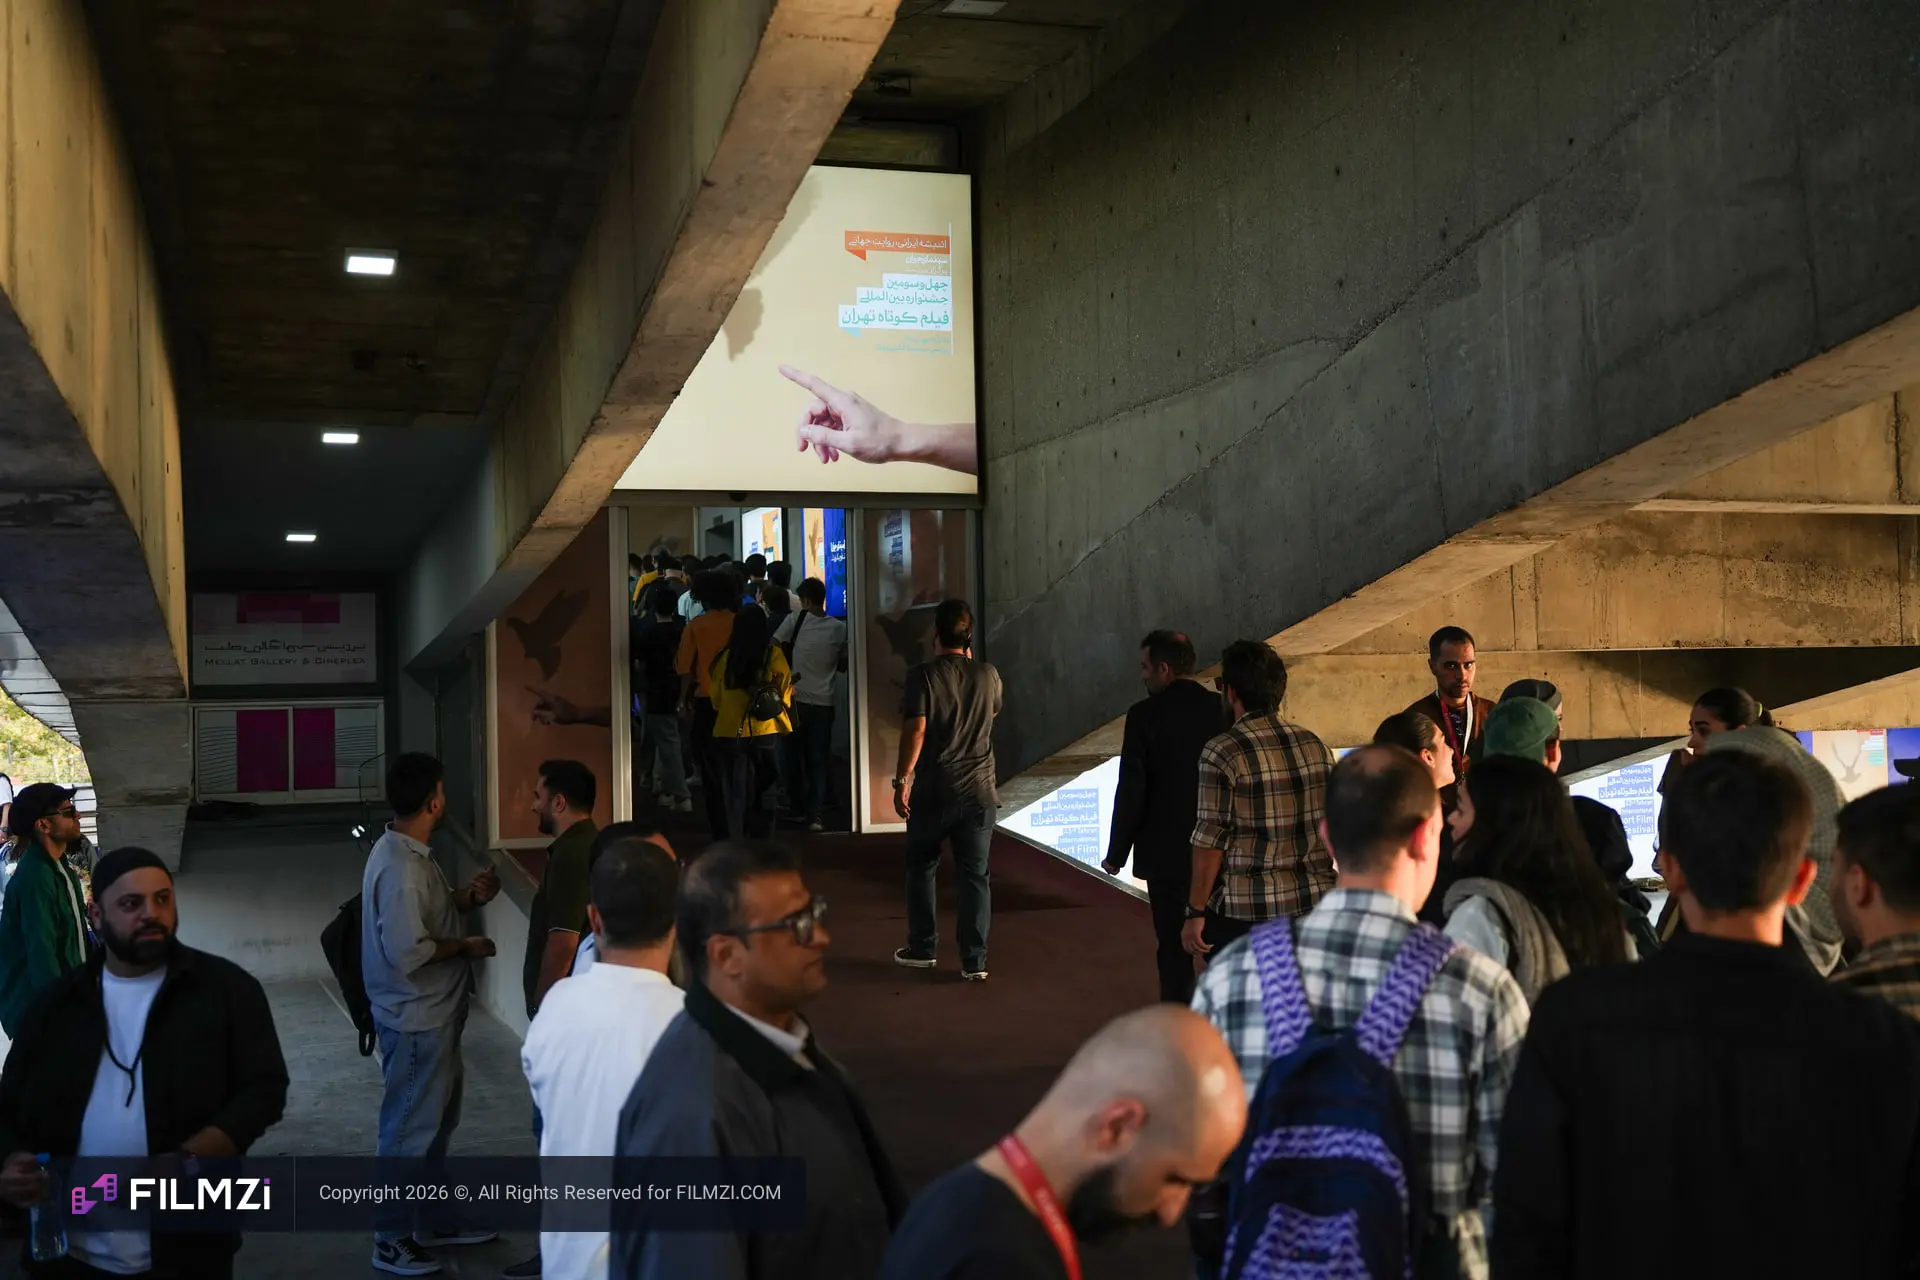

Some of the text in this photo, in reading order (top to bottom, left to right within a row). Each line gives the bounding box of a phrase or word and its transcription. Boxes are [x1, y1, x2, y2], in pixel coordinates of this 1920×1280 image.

[848, 236, 872, 247] جهانی
[919, 239, 947, 249] اندیشه
[906, 291, 948, 305] جشنواره
[841, 308, 949, 328] فیلم کوتاه تهران
[251, 657, 298, 666] GALLERY
[302, 657, 310, 665] &
[1600, 785, 1653, 798] فیلم کوتاه تهران
[1032, 811, 1098, 826] فیلم کوتاه تهران
[1637, 815, 1654, 825] Film
[1078, 844, 1098, 853] Film
